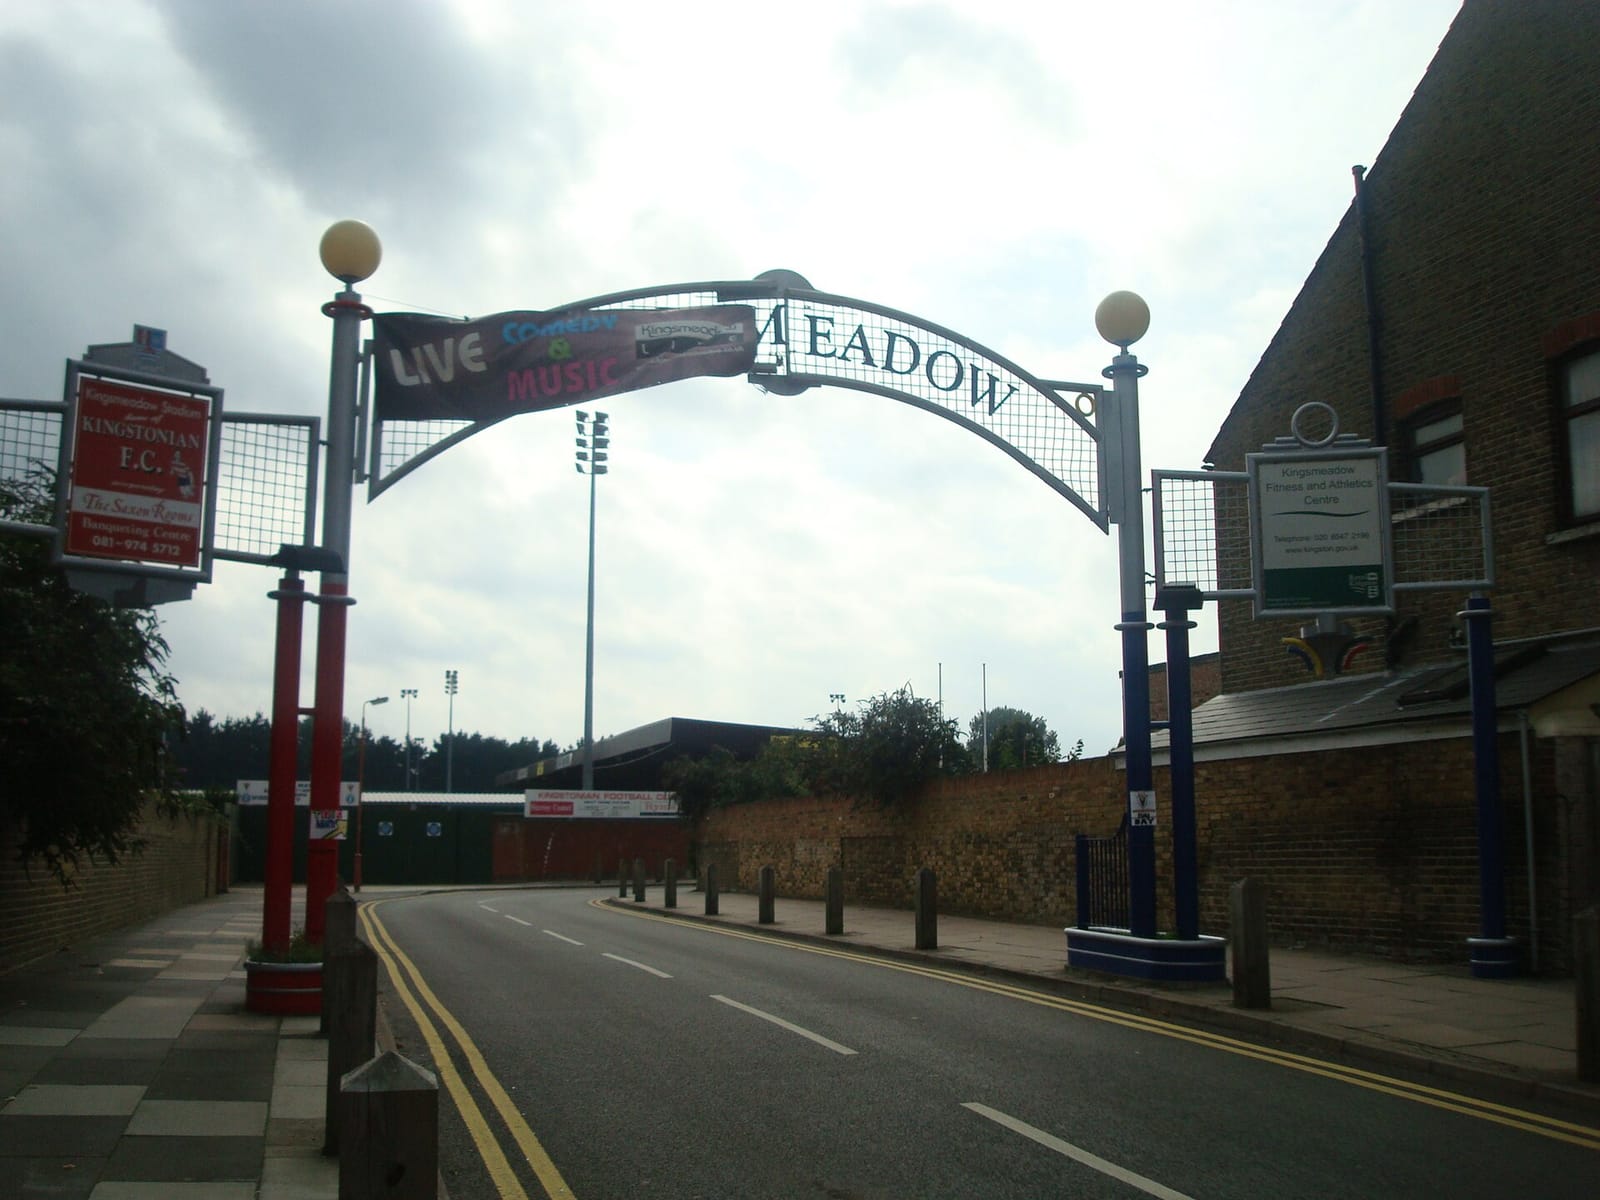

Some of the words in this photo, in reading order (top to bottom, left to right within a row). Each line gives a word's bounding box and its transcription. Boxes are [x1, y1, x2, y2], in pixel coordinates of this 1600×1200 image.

[390, 332, 487, 386] LIVE
[549, 337, 571, 360] &
[508, 357, 620, 401] MUSIC
[162, 400, 201, 418] Stadium
[82, 415, 200, 449] KINGSTONIAN
[120, 446, 163, 473] F.C.
[1282, 466, 1355, 479] Kingsmeadow
[1266, 482, 1303, 492] Fitness
[1307, 481, 1326, 490] and
[1329, 479, 1373, 490] Athletics
[83, 493, 108, 512] The
[111, 498, 150, 517] Saxon
[152, 500, 193, 523] Rooms
[1304, 495, 1339, 505] Centre
[83, 517, 149, 538] Banqueting
[153, 526, 192, 542] Centre
[604, 791, 652, 800] FOOTBALL
